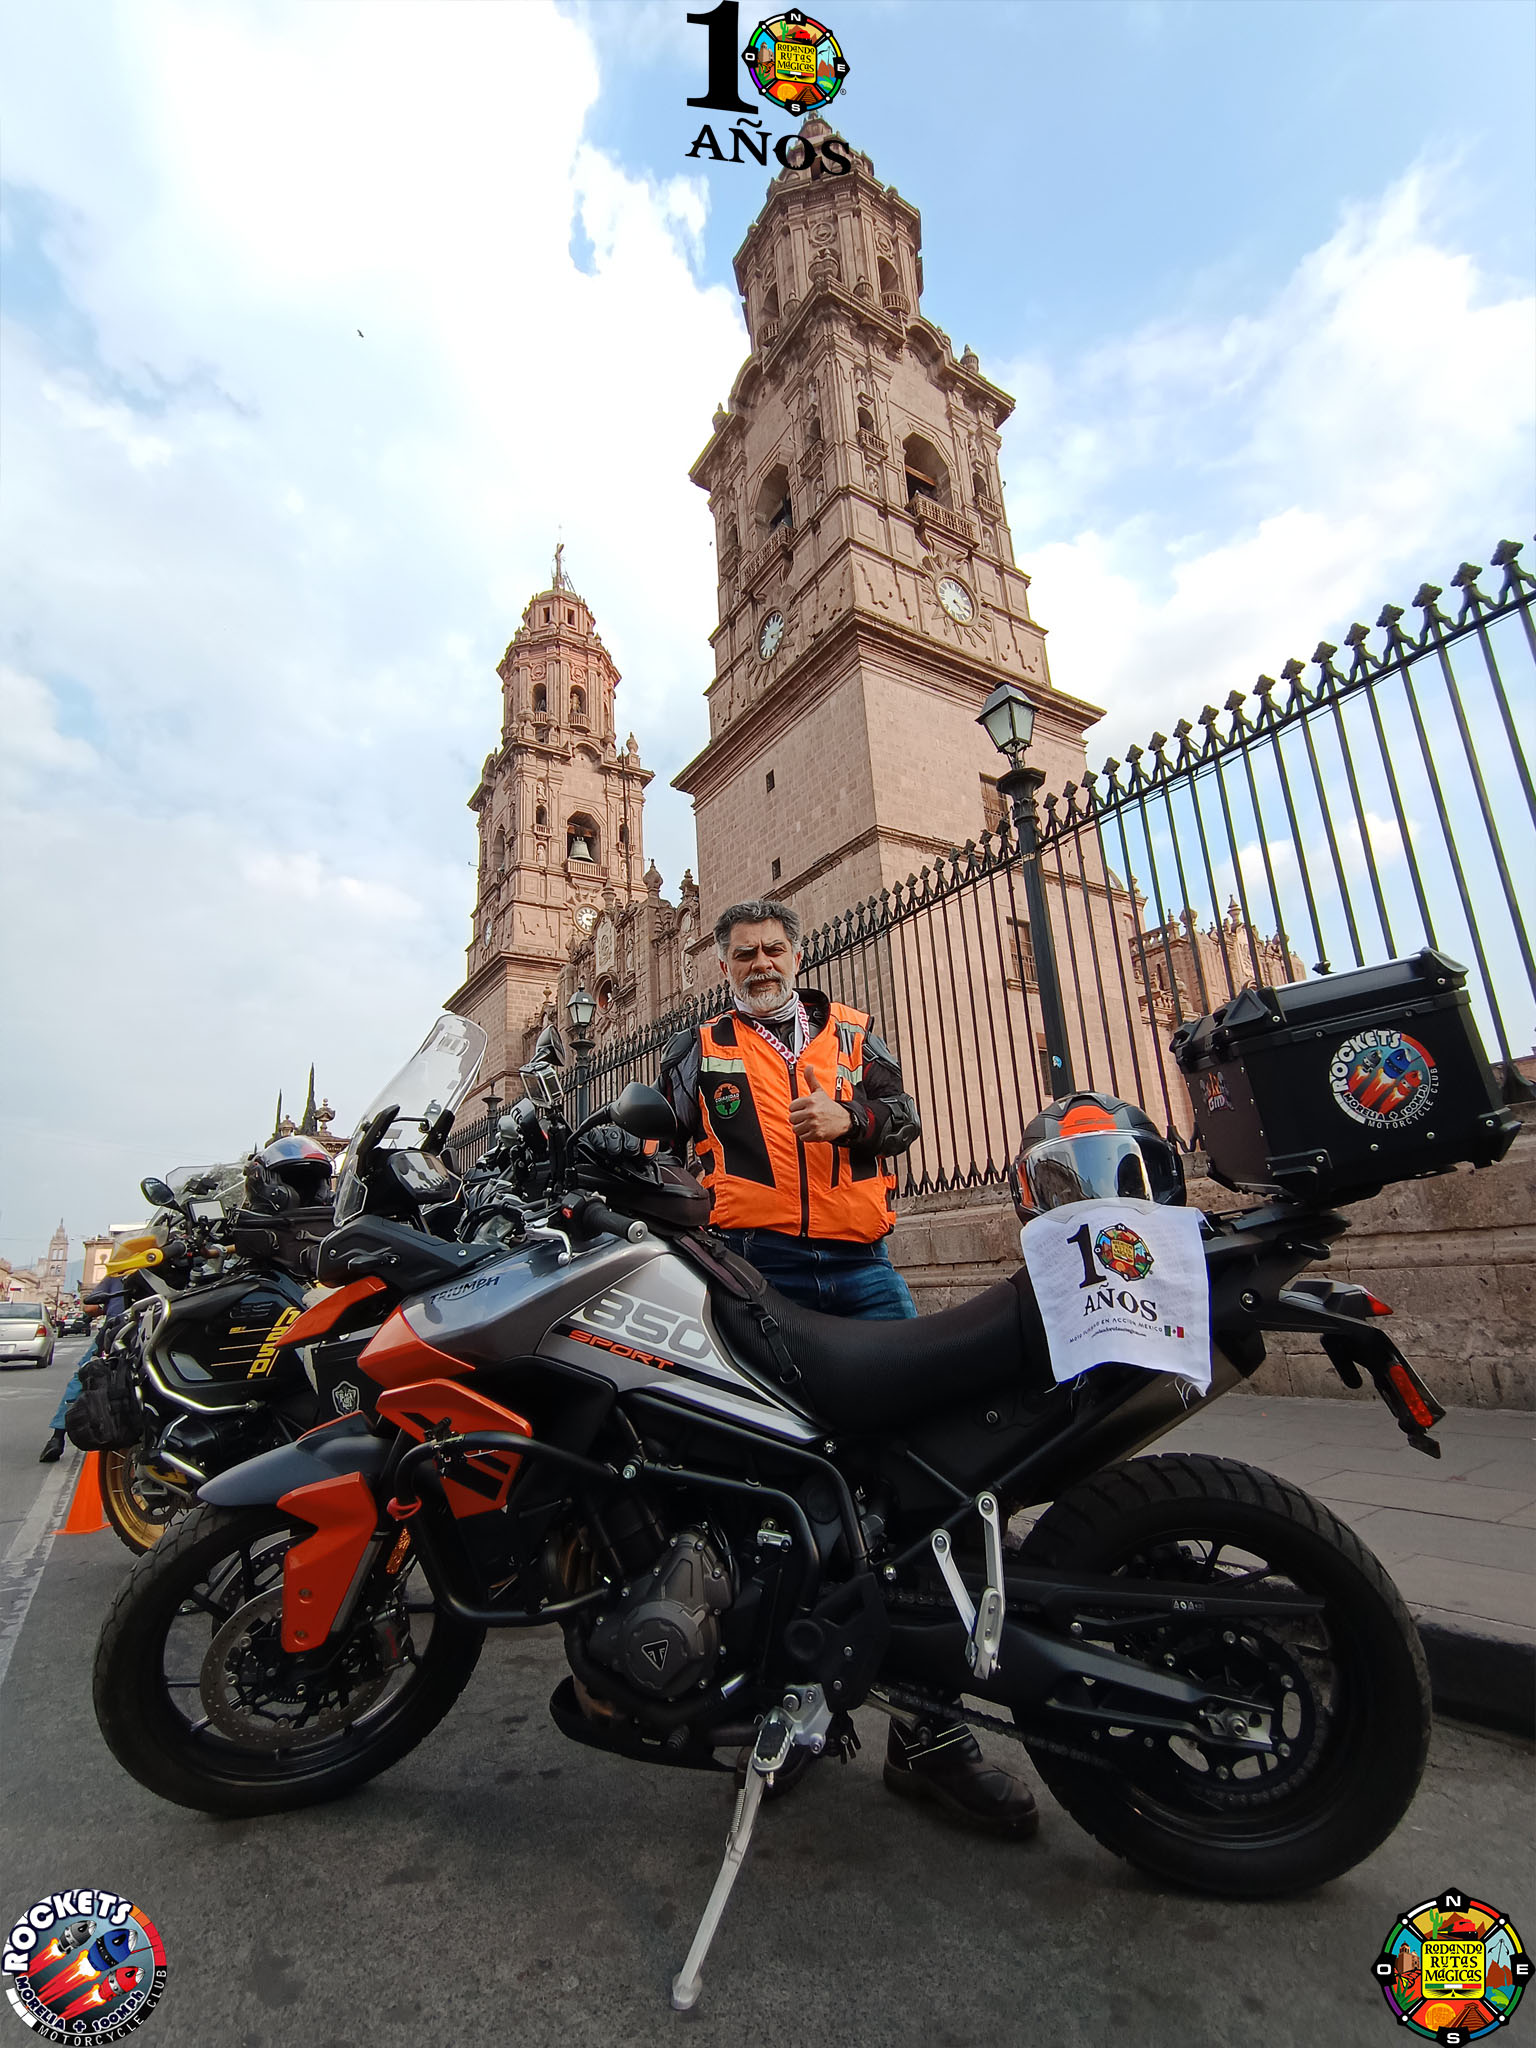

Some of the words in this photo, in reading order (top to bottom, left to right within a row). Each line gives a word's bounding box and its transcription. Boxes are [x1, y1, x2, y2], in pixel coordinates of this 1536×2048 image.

[1332, 1030, 1401, 1092] ROCKETS
[1430, 1068, 1439, 1094] CLUB
[1344, 1091, 1385, 1121] MORELIA
[1367, 1099, 1434, 1129] MOTORCYCLE
[429, 1275, 500, 1304] TRIUMPH
[1083, 1282, 1158, 1322] AÑOS
[583, 1292, 713, 1360] 850
[568, 1329, 675, 1370] SPORT
